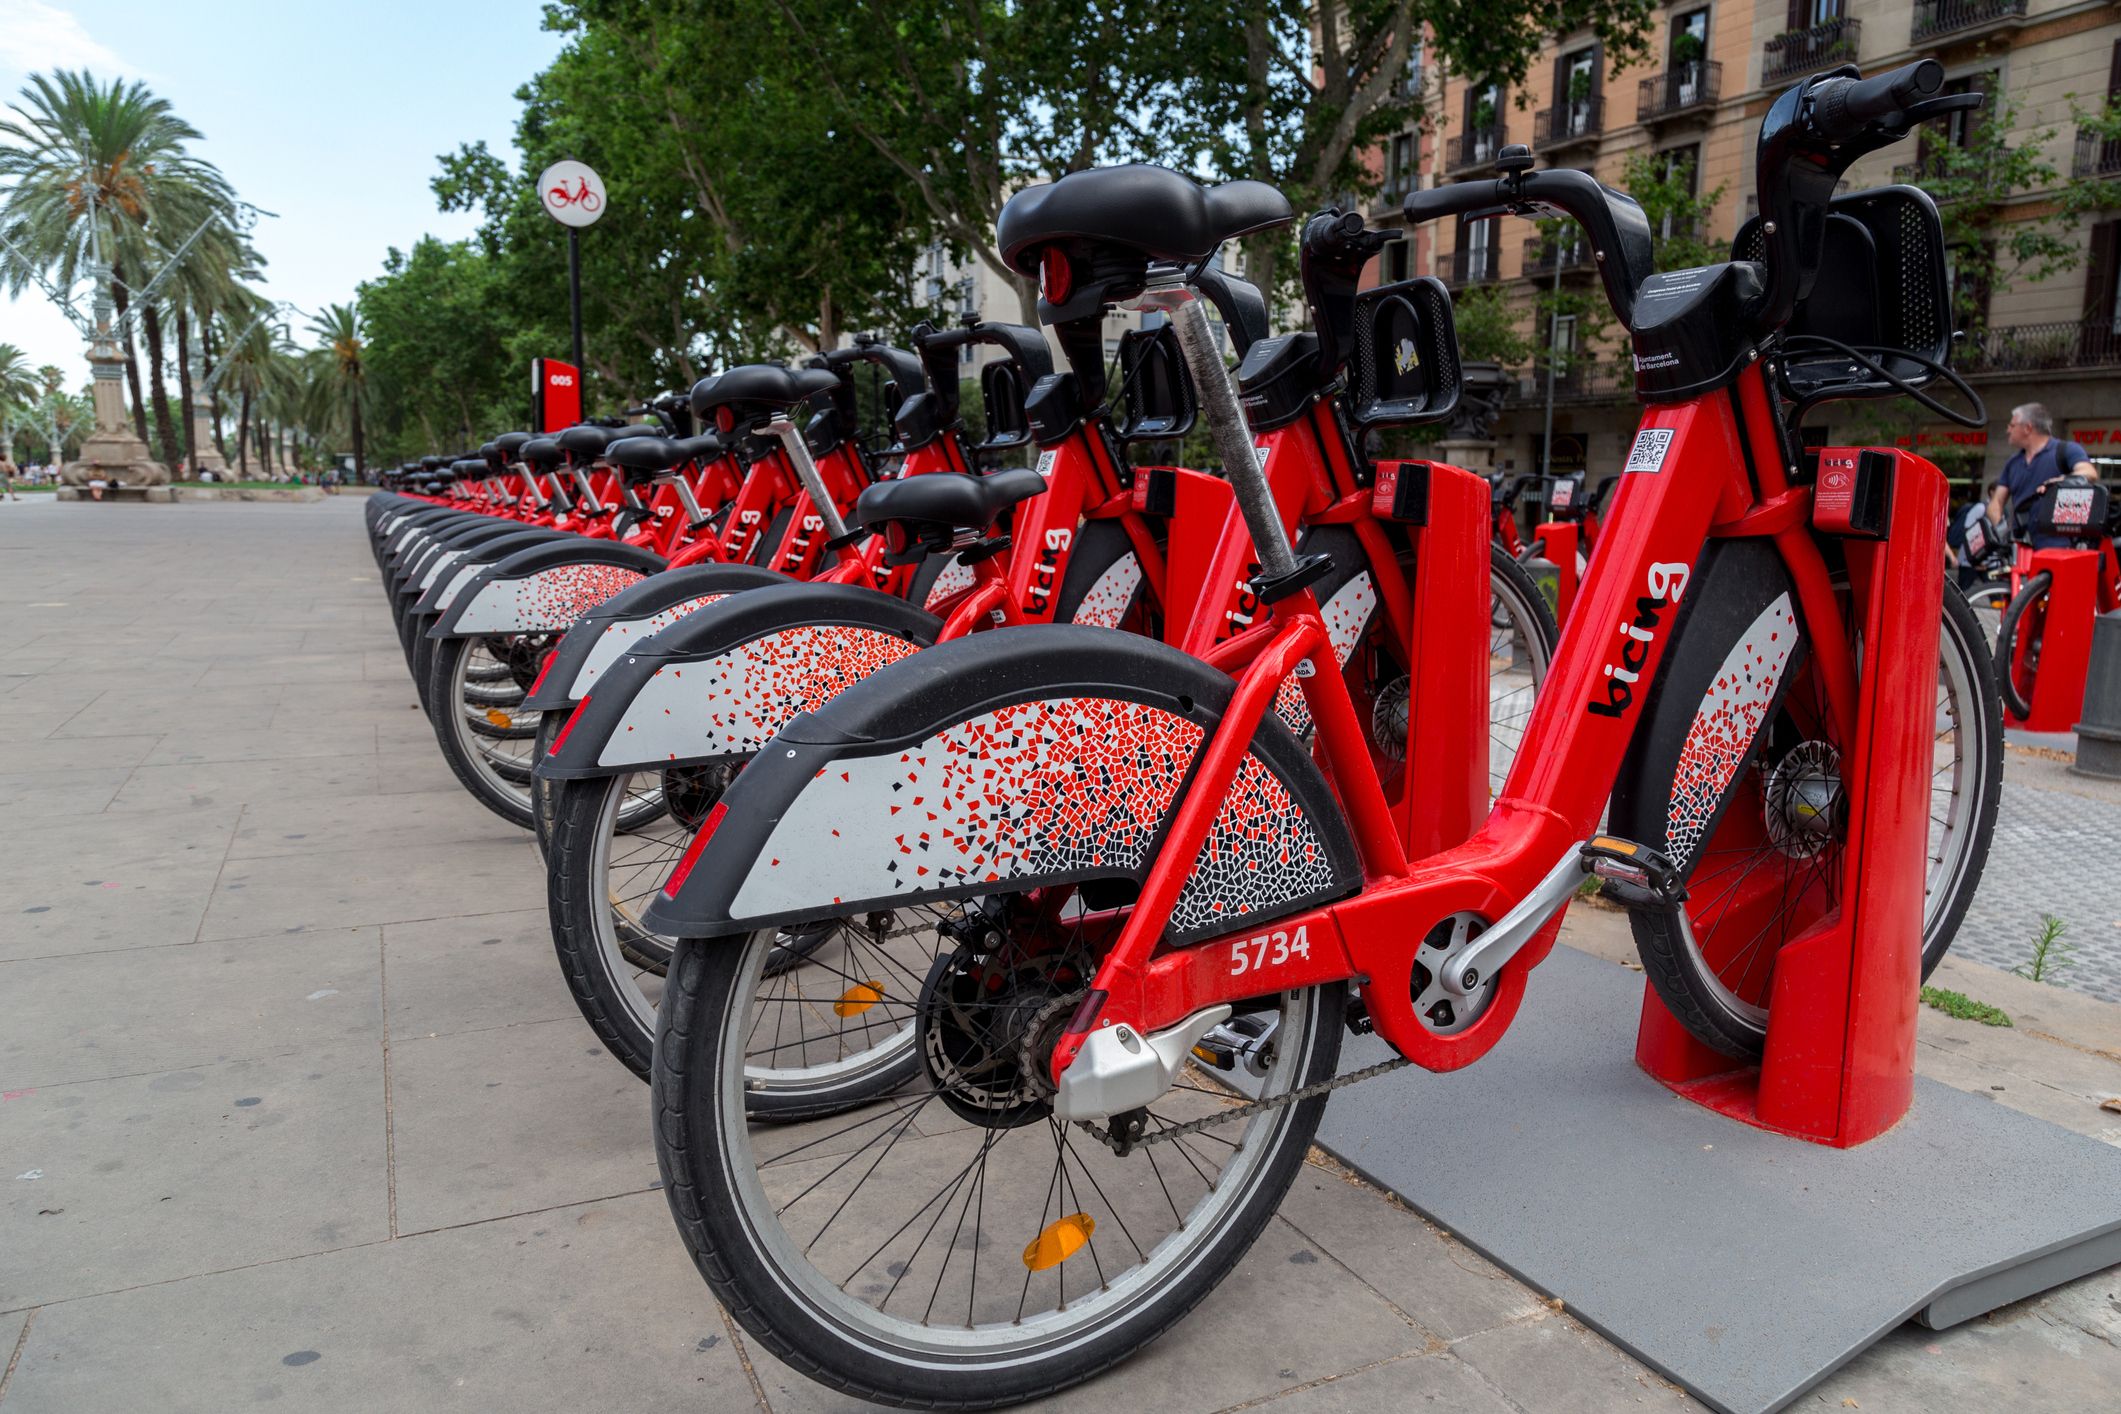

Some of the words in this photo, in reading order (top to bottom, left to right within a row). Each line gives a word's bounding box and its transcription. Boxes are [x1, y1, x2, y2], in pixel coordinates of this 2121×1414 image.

[1646, 358, 1680, 370] Barcelona
[2073, 429, 2105, 445] TOT
[780, 515, 825, 573] bicing
[1022, 528, 1072, 616] bicing
[1588, 562, 1690, 718] bicing
[1230, 925, 1310, 976] 5734
